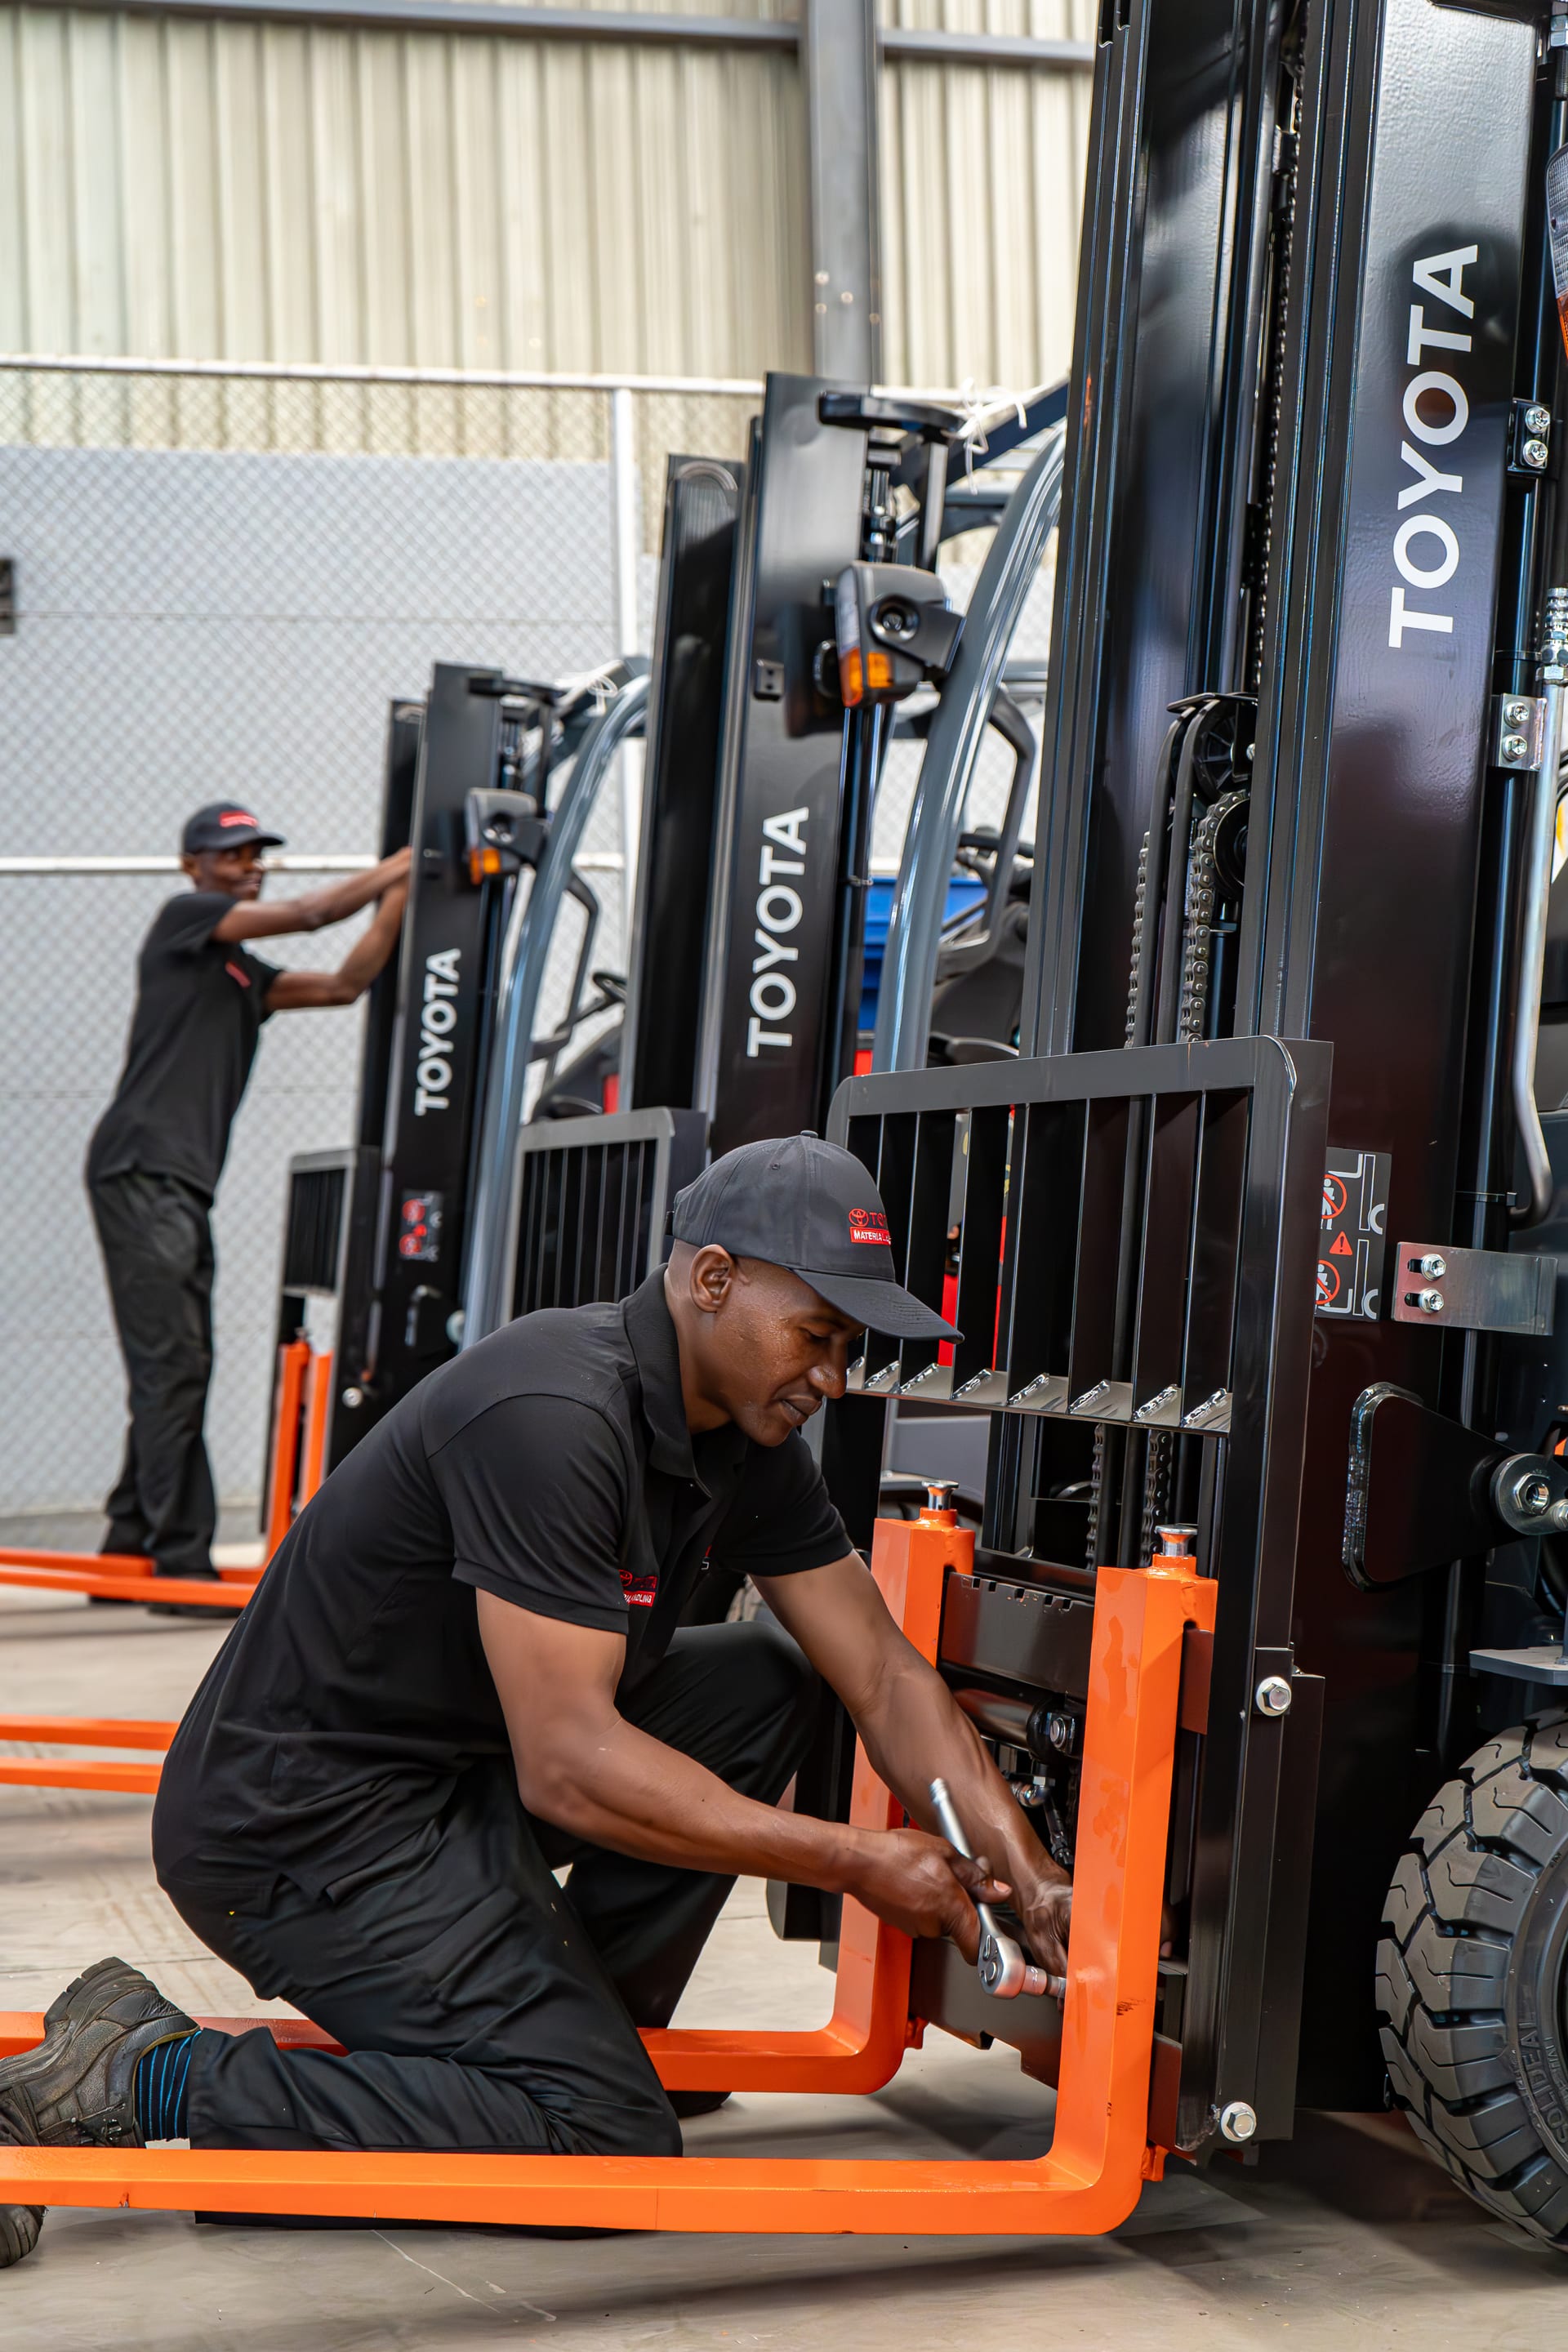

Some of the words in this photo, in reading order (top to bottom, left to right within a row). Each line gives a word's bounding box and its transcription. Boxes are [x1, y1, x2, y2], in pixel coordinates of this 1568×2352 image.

[1388, 244, 1478, 649] TOYOTA
[414, 948, 461, 1116] TOYOTA
[746, 806, 809, 1058] TOYOTA
